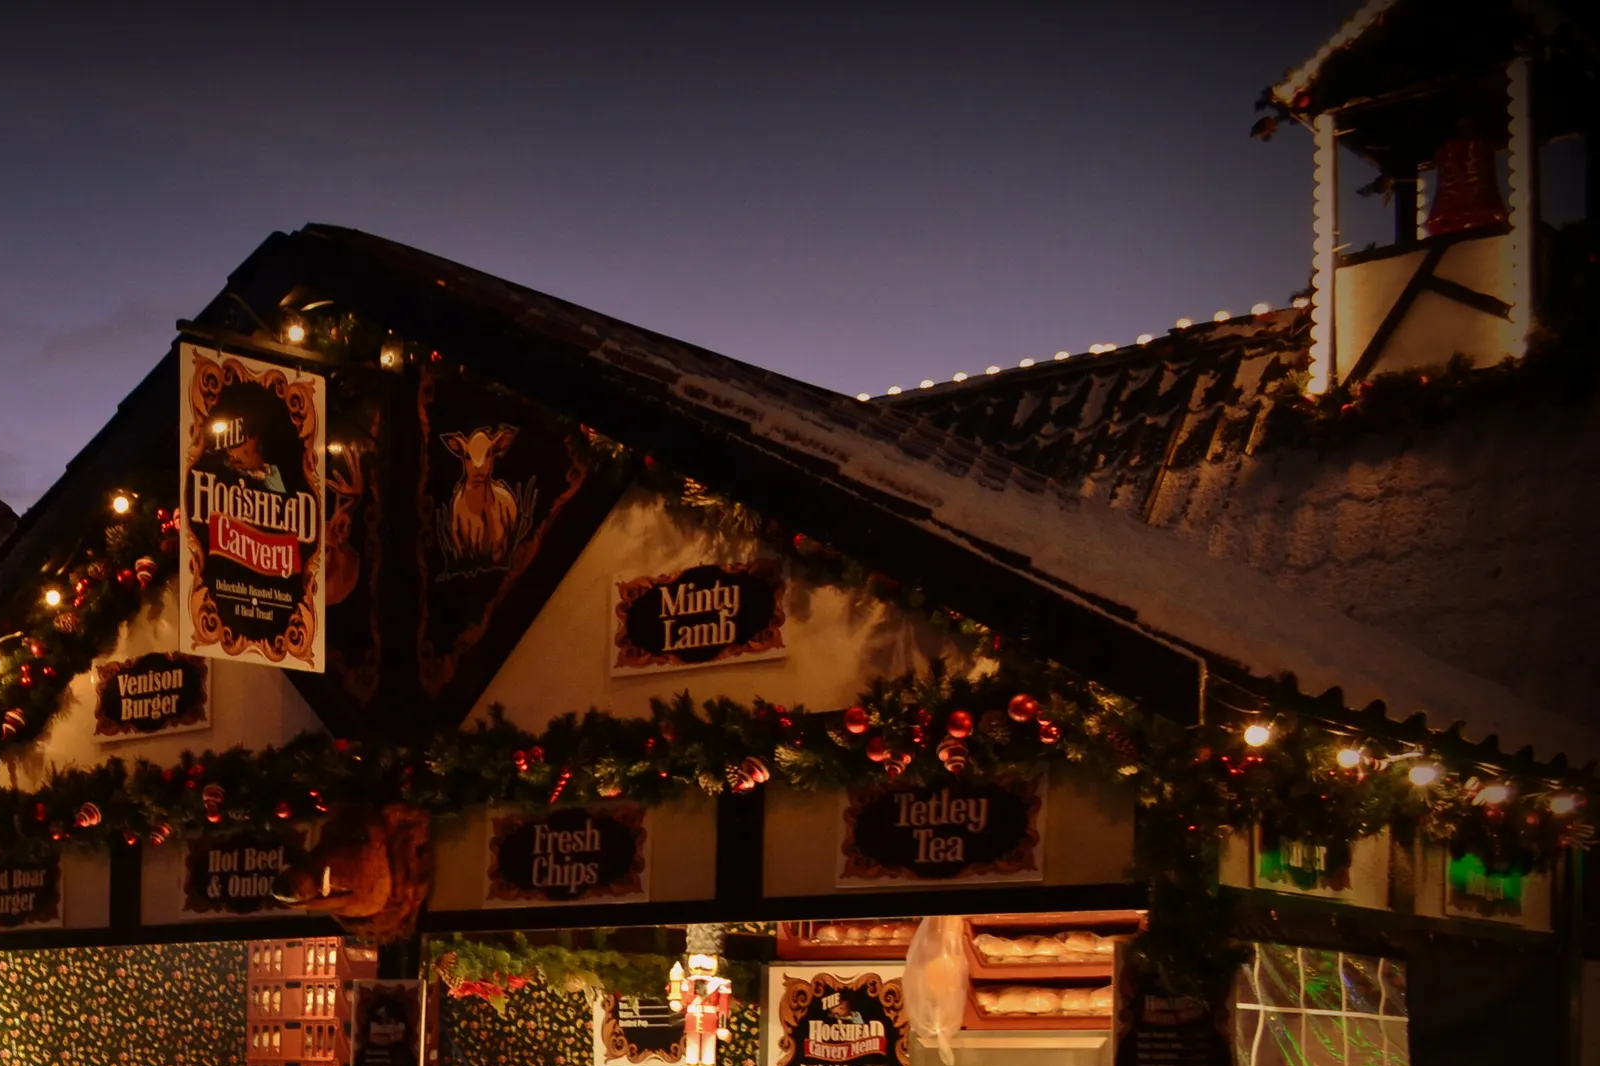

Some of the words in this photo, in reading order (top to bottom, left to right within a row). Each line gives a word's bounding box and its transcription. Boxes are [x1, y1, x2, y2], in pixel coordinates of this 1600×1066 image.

[213, 417, 245, 450] THE
[217, 515, 294, 579] Carvery
[658, 579, 742, 619] Minty
[661, 611, 738, 652] Lamb
[116, 668, 184, 698] Venison
[120, 693, 180, 722] Burger
[893, 786, 991, 833] Tetley
[531, 818, 601, 855] Fresh
[912, 828, 967, 864] Tea
[208, 849, 240, 874] Hot
[531, 853, 599, 893] Chips
[12, 868, 47, 890] Boar
[206, 874, 224, 899] &
[821, 992, 841, 1011] THE
[809, 1041, 849, 1060] Carvery
[850, 1037, 880, 1056] Menu
